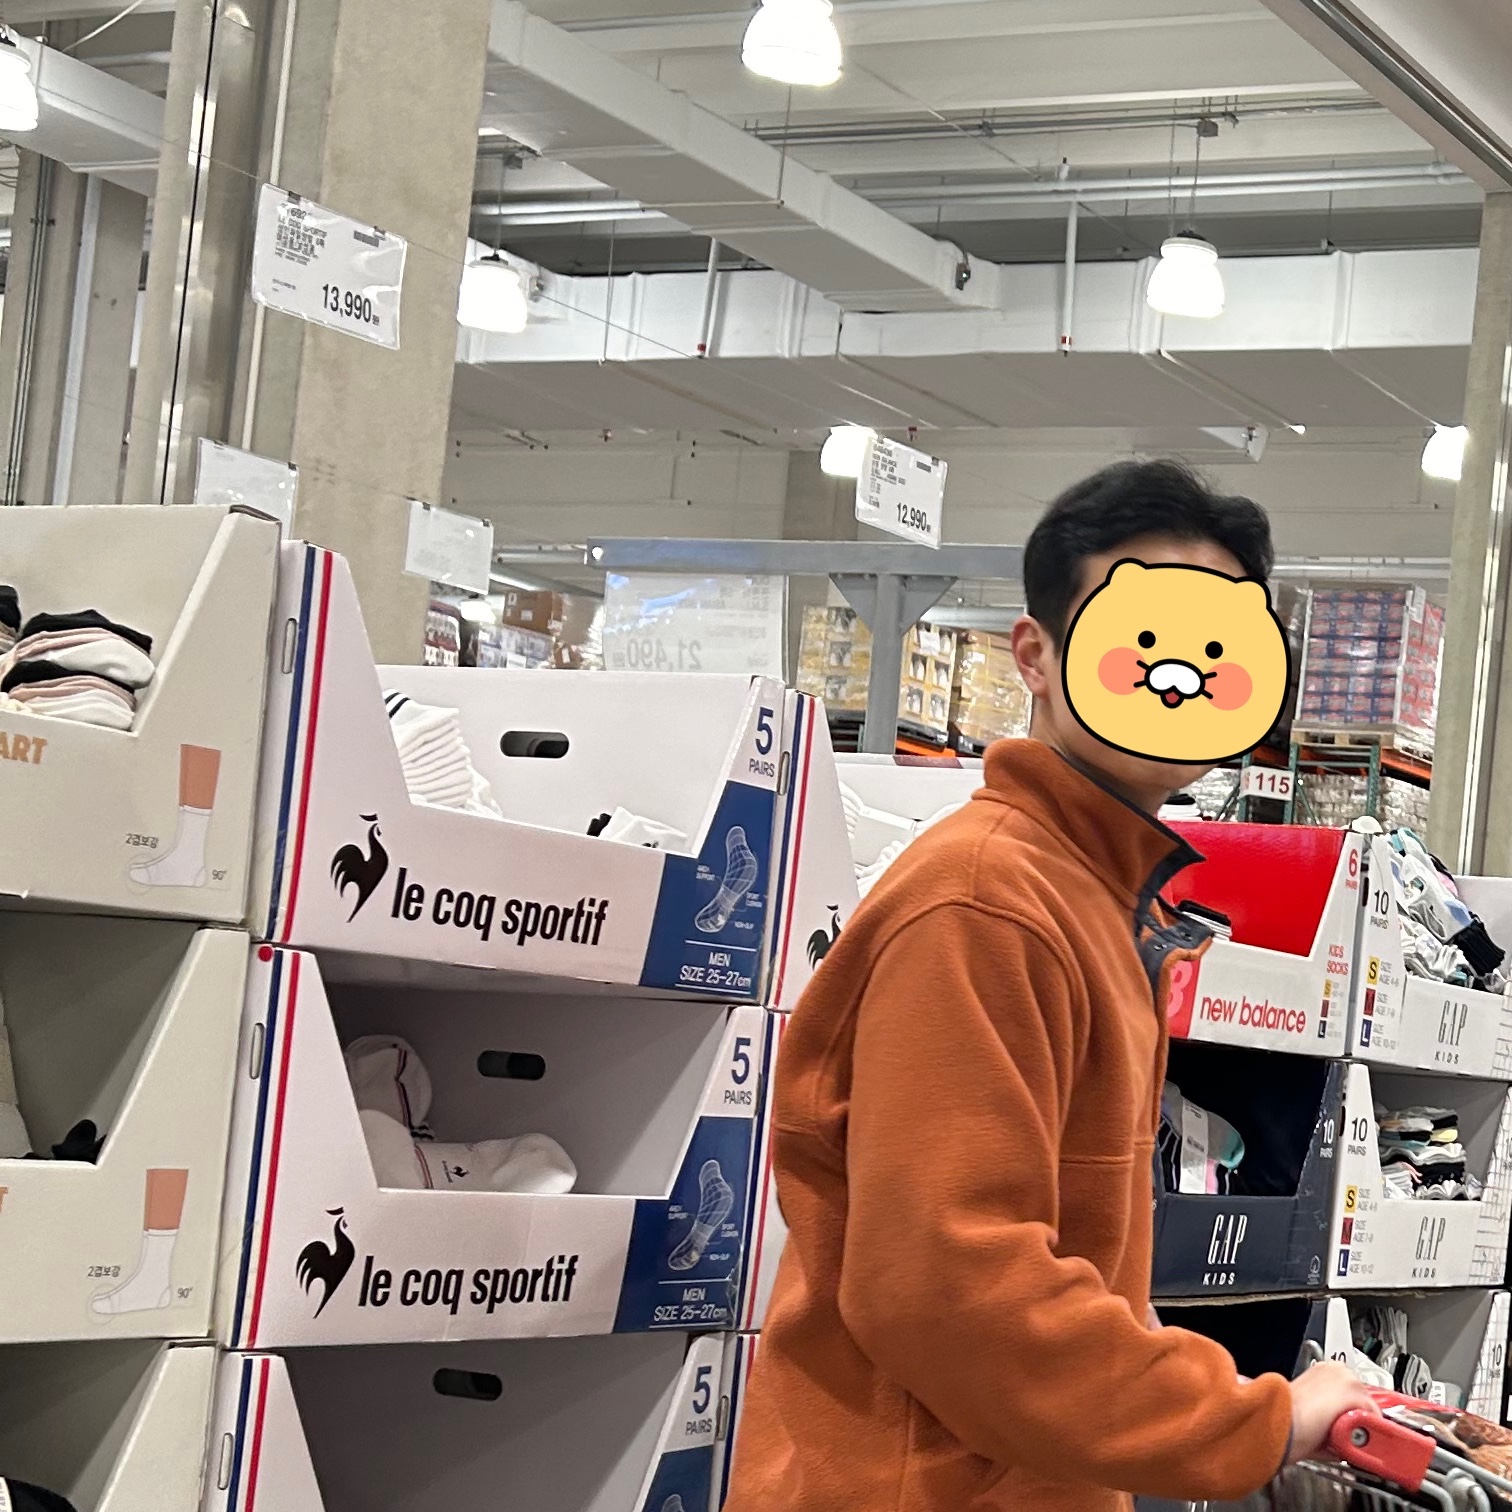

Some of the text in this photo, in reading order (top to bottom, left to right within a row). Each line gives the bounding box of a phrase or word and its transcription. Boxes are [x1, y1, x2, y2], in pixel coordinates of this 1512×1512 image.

[322, 283, 372, 323] 13,990
[897, 502, 927, 532] 12,990
[754, 707, 774, 755] 5
[749, 758, 775, 778] PAIRS
[1256, 772, 1290, 794] 115
[1348, 849, 1358, 877] 6
[391, 867, 609, 946] le coq sportif
[1374, 889, 1389, 915] 10
[709, 952, 731, 967] MEN
[1368, 961, 1377, 981] S
[680, 965, 705, 983] SIZE
[1200, 996, 1238, 1023] new
[1239, 995, 1307, 1034] balance
[1438, 1000, 1468, 1046] GAP
[1362, 1022, 1369, 1043] L
[730, 1037, 752, 1084] 5
[1435, 1051, 1460, 1064] KIDS
[724, 1089, 752, 1106] PAIRS
[1323, 1119, 1334, 1144] 10
[1351, 1118, 1368, 1142] 10
[1347, 1145, 1366, 1156] PAIRS
[1346, 1189, 1355, 1208] S
[1207, 1214, 1248, 1265] GAP
[1415, 1216, 1446, 1260] GAP
[1339, 1253, 1346, 1272] L
[1411, 1267, 1437, 1279] KIDS
[358, 1255, 579, 1315] le coq sportif
[1202, 1272, 1235, 1285] KIDS
[682, 1288, 706, 1302] MEN
[653, 1305, 679, 1322] SIZE
[692, 1365, 711, 1414] 5
